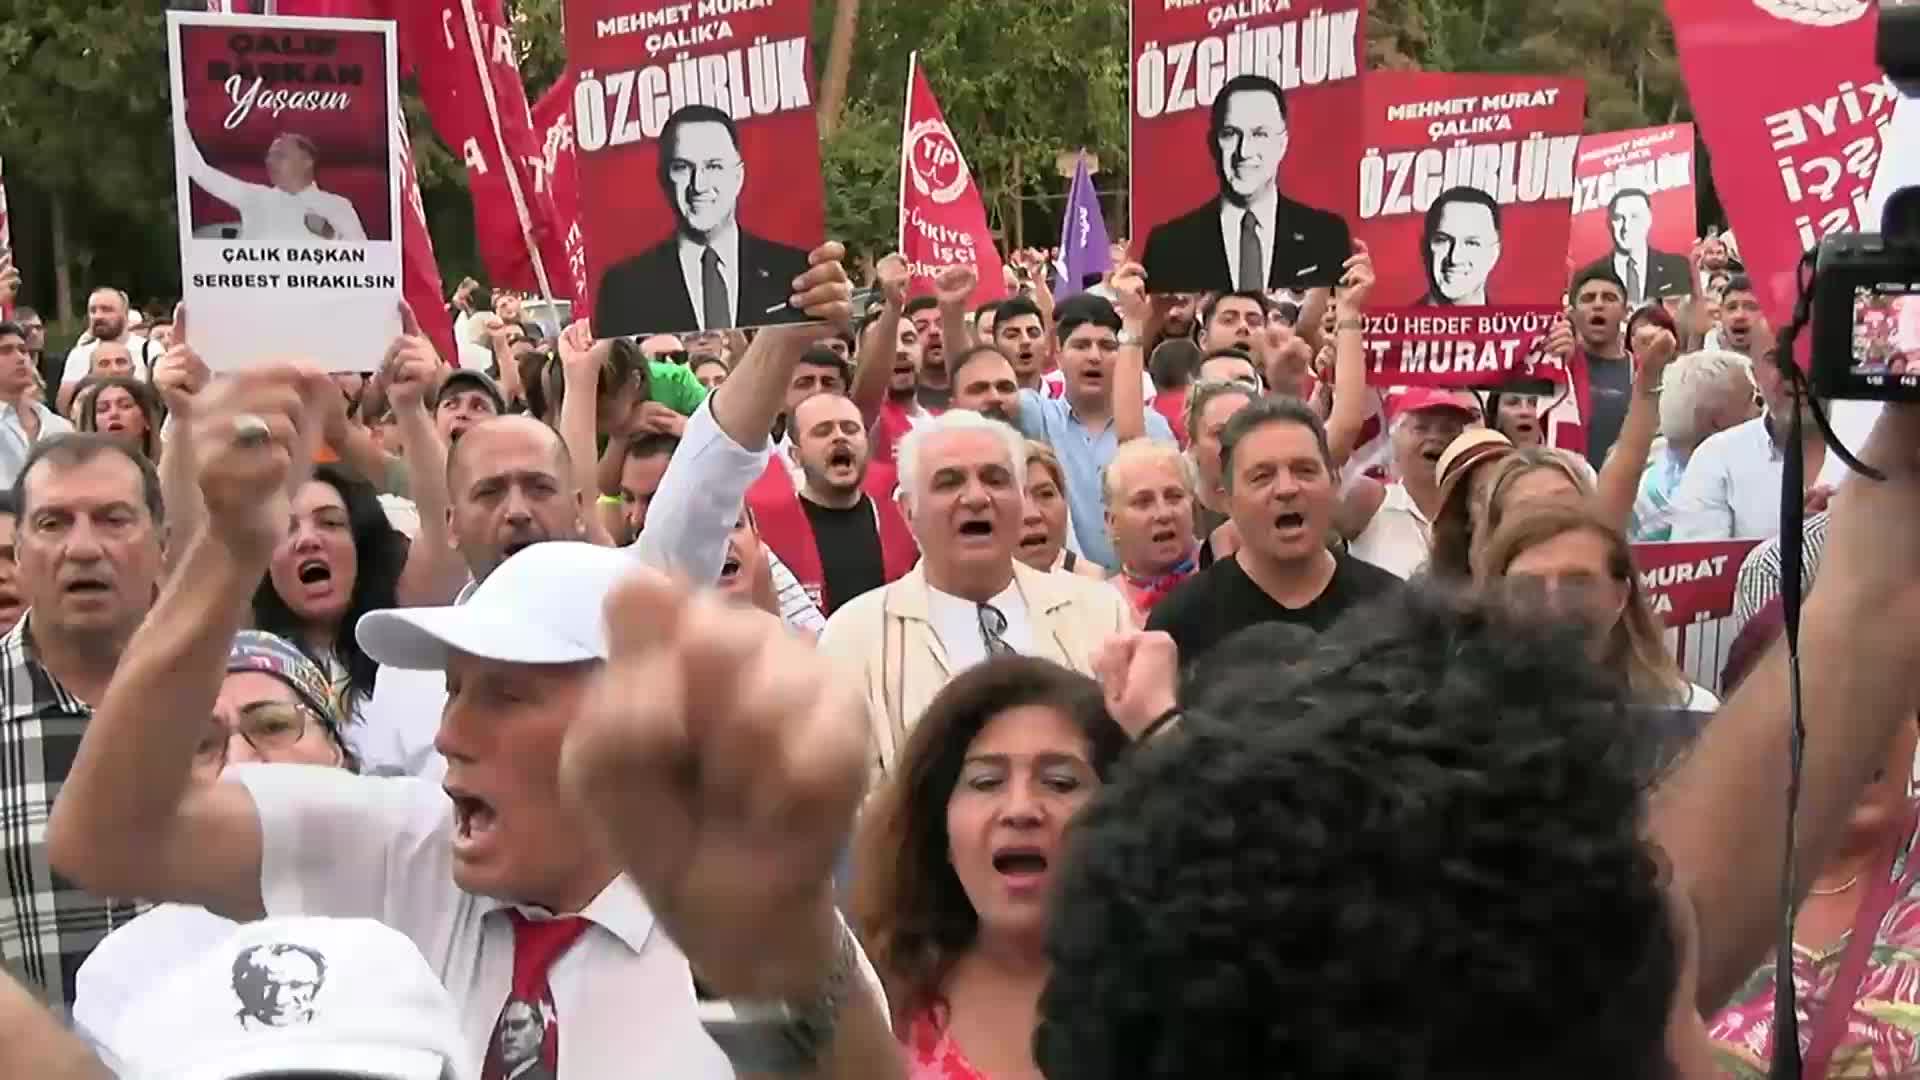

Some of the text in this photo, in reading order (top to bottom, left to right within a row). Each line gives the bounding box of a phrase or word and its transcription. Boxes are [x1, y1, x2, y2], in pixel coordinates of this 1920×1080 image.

[596, 2, 692, 38] MEHMET
[645, 20, 733, 57] ÇALIK'A
[1136, 7, 1359, 118] ÖZGÜRLÜK
[224, 73, 351, 129] Yaşasın
[574, 35, 811, 151] ÖZGÜRLÜK
[1388, 88, 1559, 121] MEHMET MURAT
[1428, 114, 1512, 142] ÇALIK'A
[1359, 131, 1581, 218] ÖZGÜRLÜK
[222, 249, 365, 265] ÇALIK BAŞKAN
[193, 274, 395, 289] SERBEST BIRAKILSIN
[1404, 316, 1473, 335] HEDEF
[1400, 340, 1520, 373] MURAT
[1639, 554, 1729, 589] MURAT
